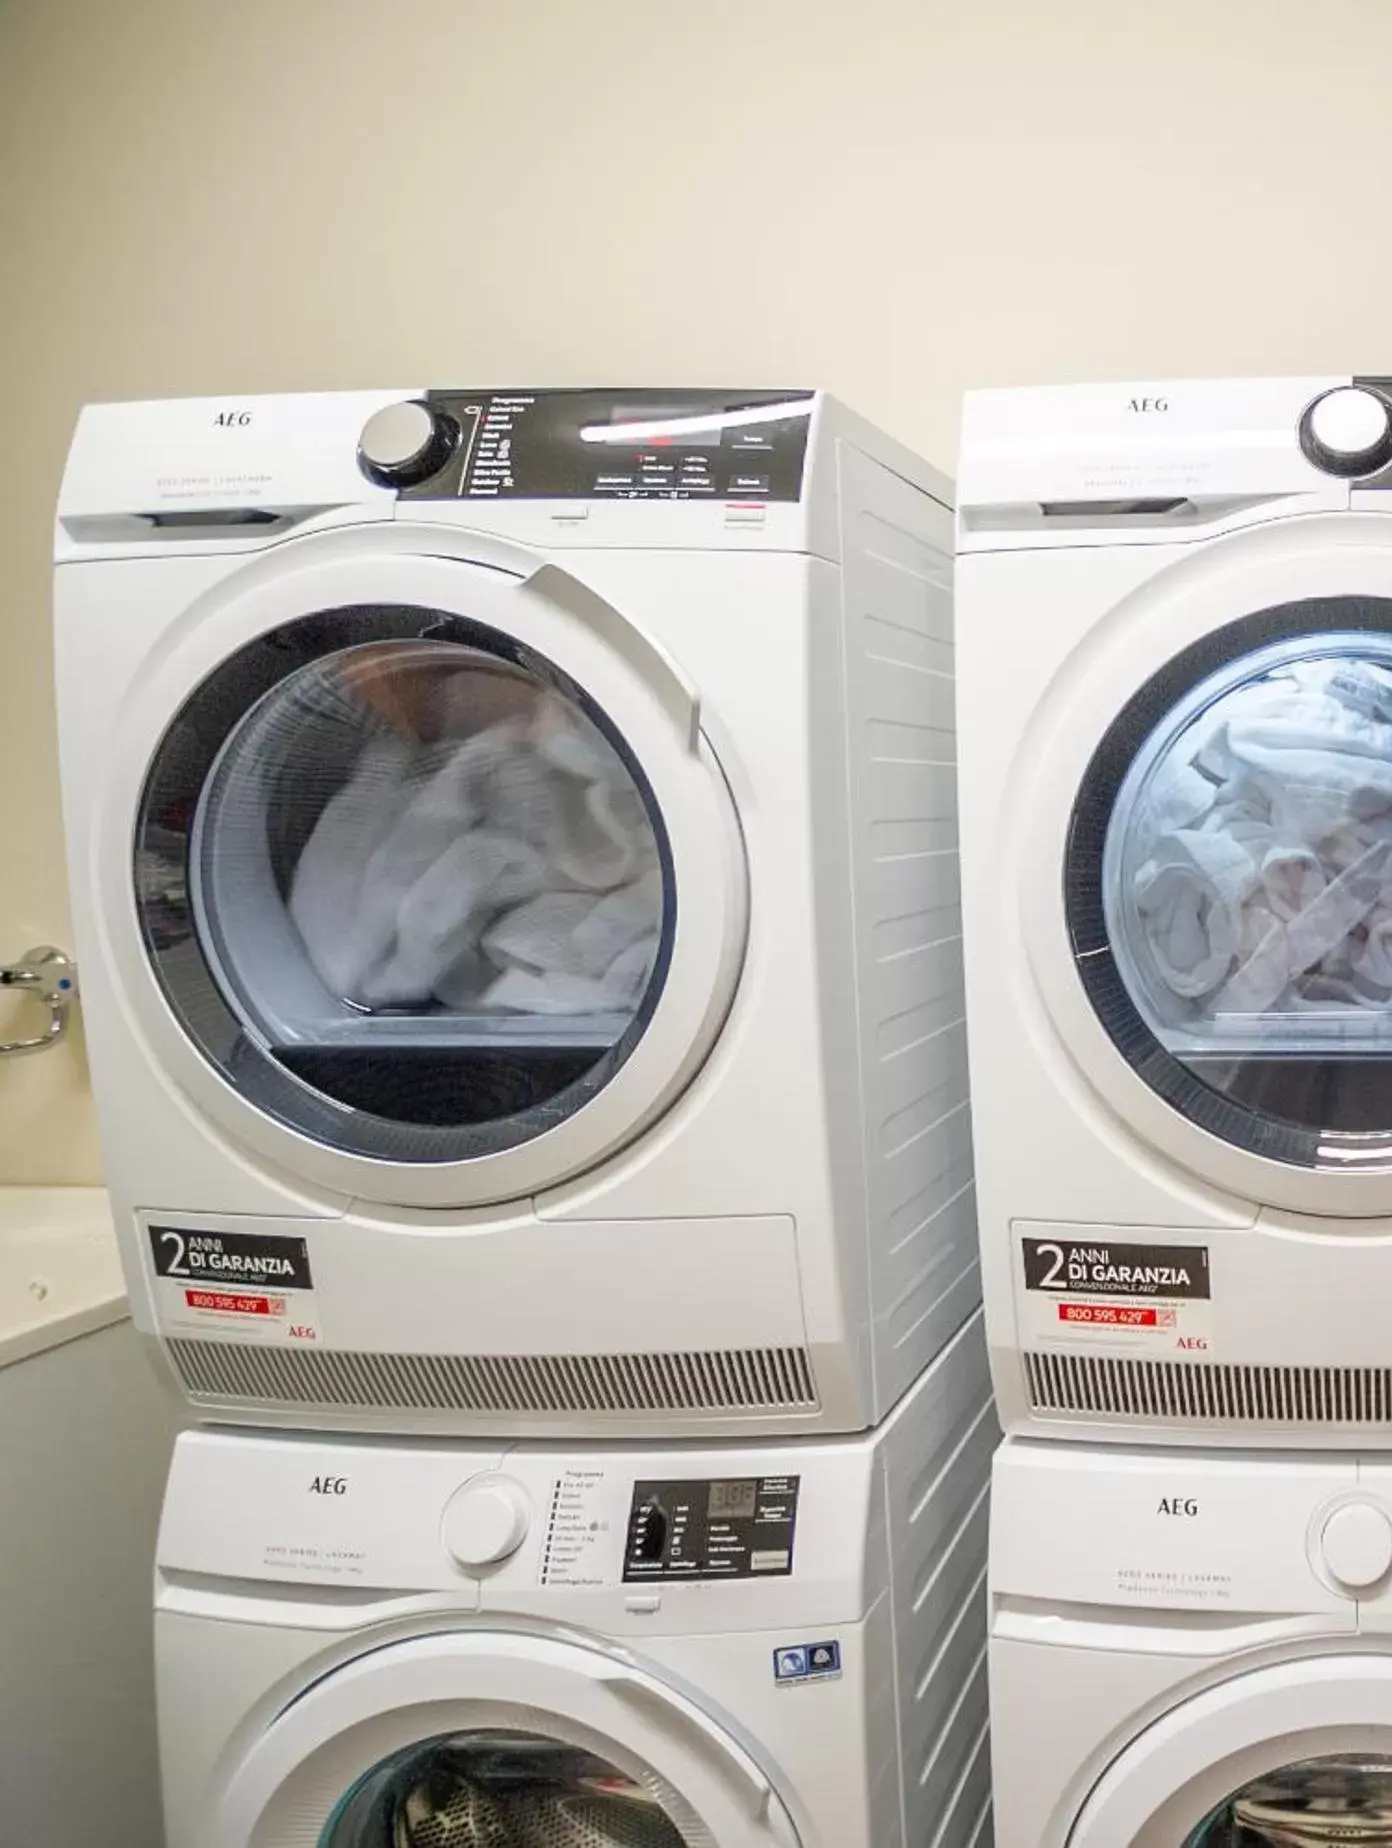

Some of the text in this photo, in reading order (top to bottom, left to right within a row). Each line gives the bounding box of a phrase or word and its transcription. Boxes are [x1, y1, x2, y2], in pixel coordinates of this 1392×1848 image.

[1127, 398, 1169, 413] AEG
[213, 411, 253, 427] AEG
[188, 1237, 223, 1253] ANNI
[161, 1231, 190, 1276] 2
[1068, 1248, 1110, 1264] ANNI
[189, 1252, 295, 1276] DI GARANZIA
[1036, 1243, 1067, 1288] 2
[1068, 1264, 1191, 1286] DI GARANZIA
[192, 1294, 214, 1307] 800
[1066, 1307, 1092, 1321] 800
[1094, 1308, 1117, 1322] 595
[288, 1325, 316, 1340] AEG
[1176, 1336, 1208, 1350] AEG
[309, 1476, 348, 1495] AEG
[1157, 1498, 1198, 1517] AEG
